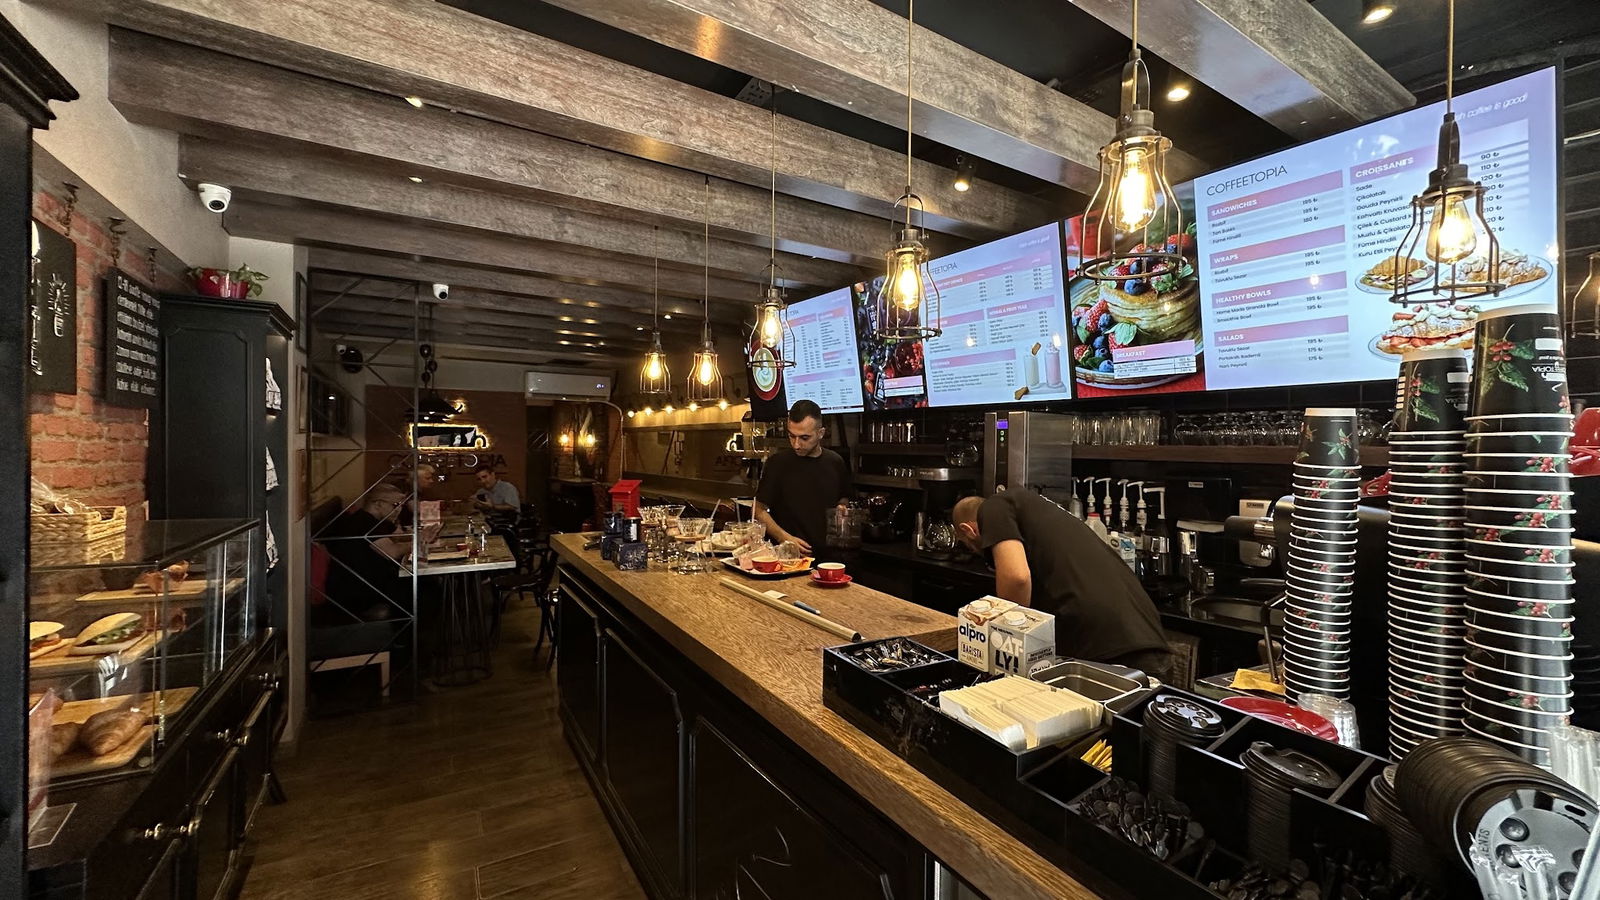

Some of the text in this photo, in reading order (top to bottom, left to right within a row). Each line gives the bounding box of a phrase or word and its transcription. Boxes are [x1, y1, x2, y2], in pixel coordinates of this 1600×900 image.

[1206, 165, 1288, 196] COFFEETOPIA
[1211, 199, 1258, 217] SANDWICHES
[1214, 254, 1239, 264] WRAPS
[1216, 289, 1272, 304] HEALTHY BOWLS
[1218, 334, 1244, 342] SALADS
[959, 623, 986, 643] alpro
[995, 649, 1019, 674] LY!
